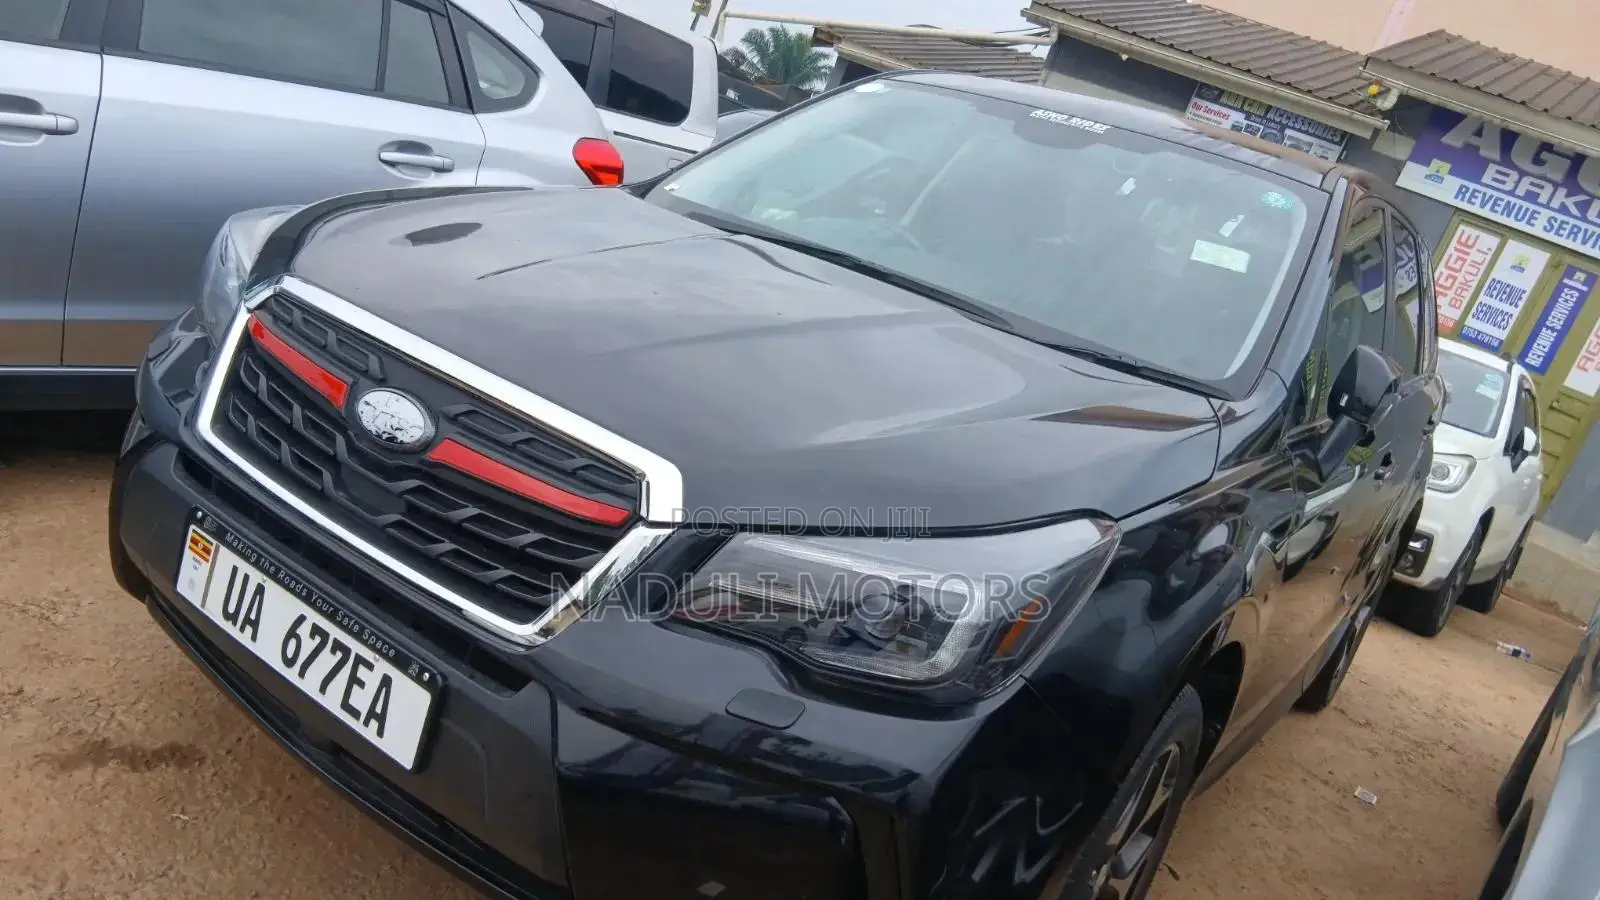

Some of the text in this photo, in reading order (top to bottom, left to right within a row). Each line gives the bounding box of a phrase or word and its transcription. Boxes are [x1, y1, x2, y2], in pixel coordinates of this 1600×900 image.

[1203, 105, 1230, 120] Services
[1454, 183, 1541, 228] REVENUE
[1483, 278, 1527, 309] REVENUE
[1472, 302, 1514, 331] SERVICES
[1525, 327, 1558, 368] REVENUE
[1546, 287, 1580, 331] SERVICES
[224, 532, 396, 658] Making the Roads Your Safe Space
[222, 565, 393, 739] UA 677EA
